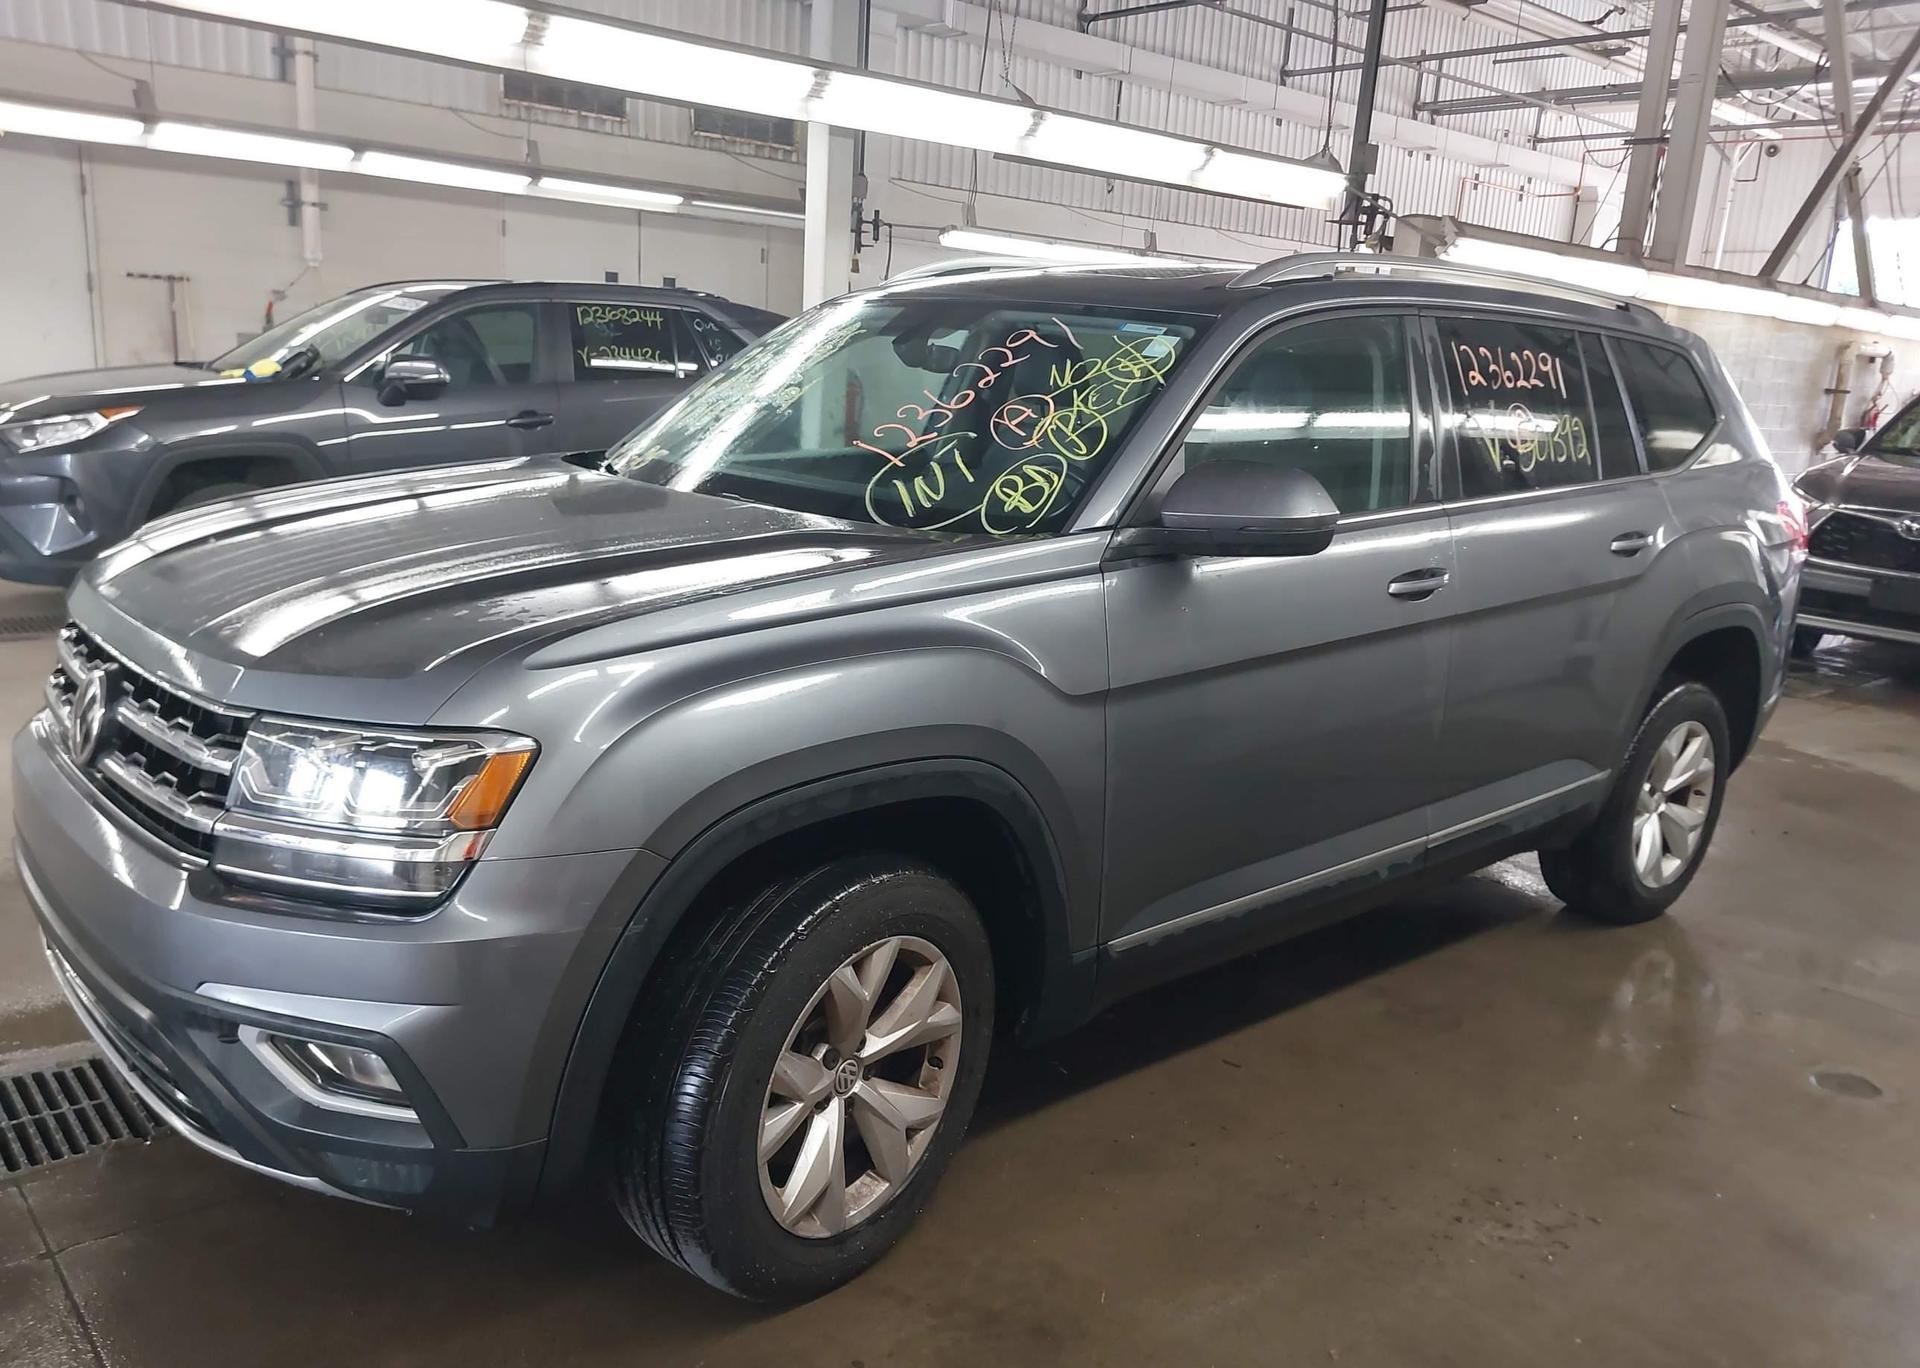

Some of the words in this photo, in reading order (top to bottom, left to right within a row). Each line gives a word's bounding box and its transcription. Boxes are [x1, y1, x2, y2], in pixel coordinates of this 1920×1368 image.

[853, 316, 1084, 467] 12362291
[1452, 341, 1566, 399] 12362291
[892, 439, 974, 518] INT
